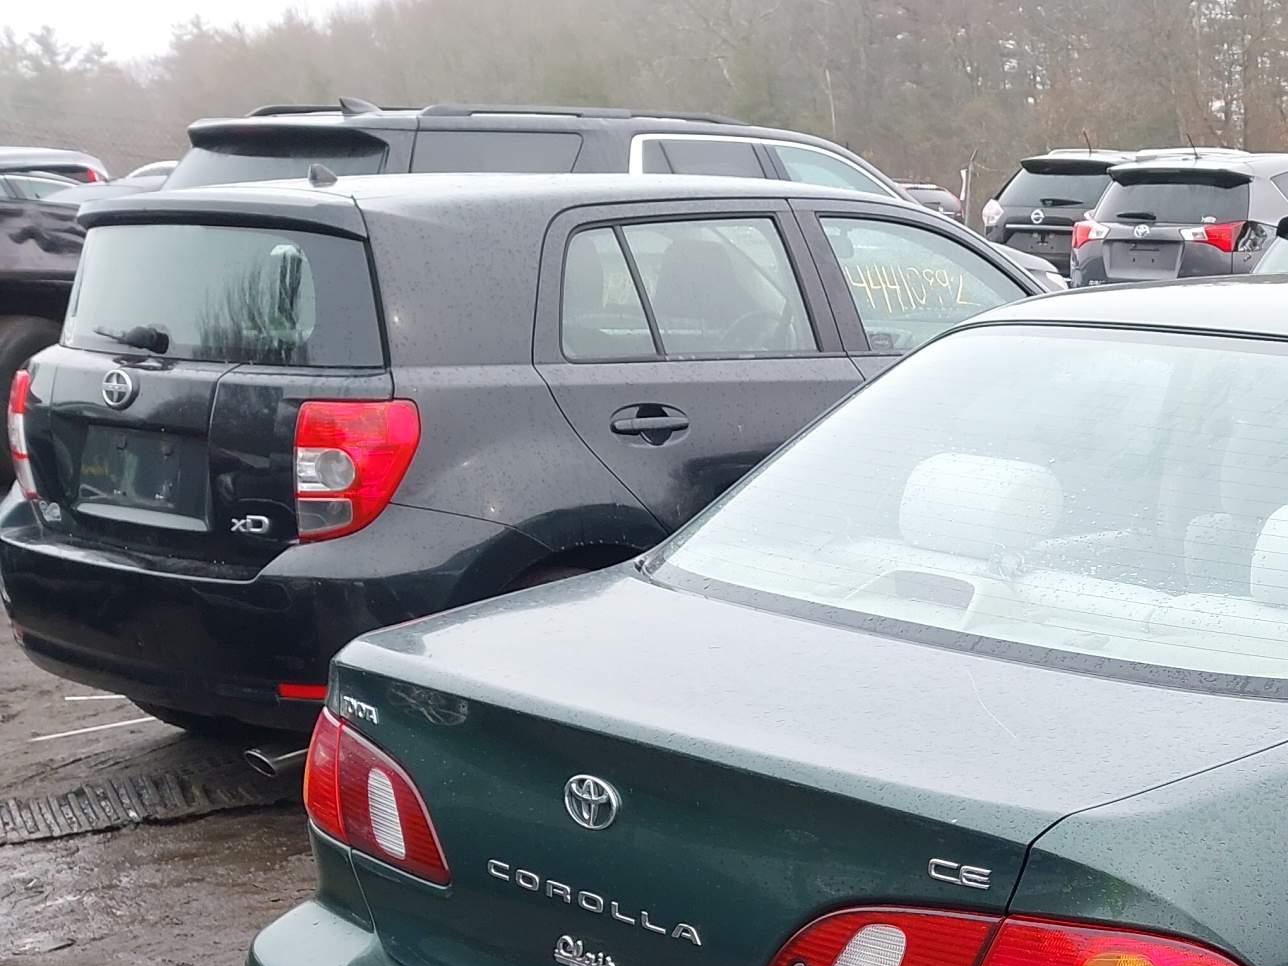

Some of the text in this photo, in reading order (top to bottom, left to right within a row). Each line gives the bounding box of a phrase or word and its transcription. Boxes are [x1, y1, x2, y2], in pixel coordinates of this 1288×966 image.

[231, 515, 269, 533] xD
[928, 858, 992, 889] CE
[487, 859, 702, 946] COROLLA
